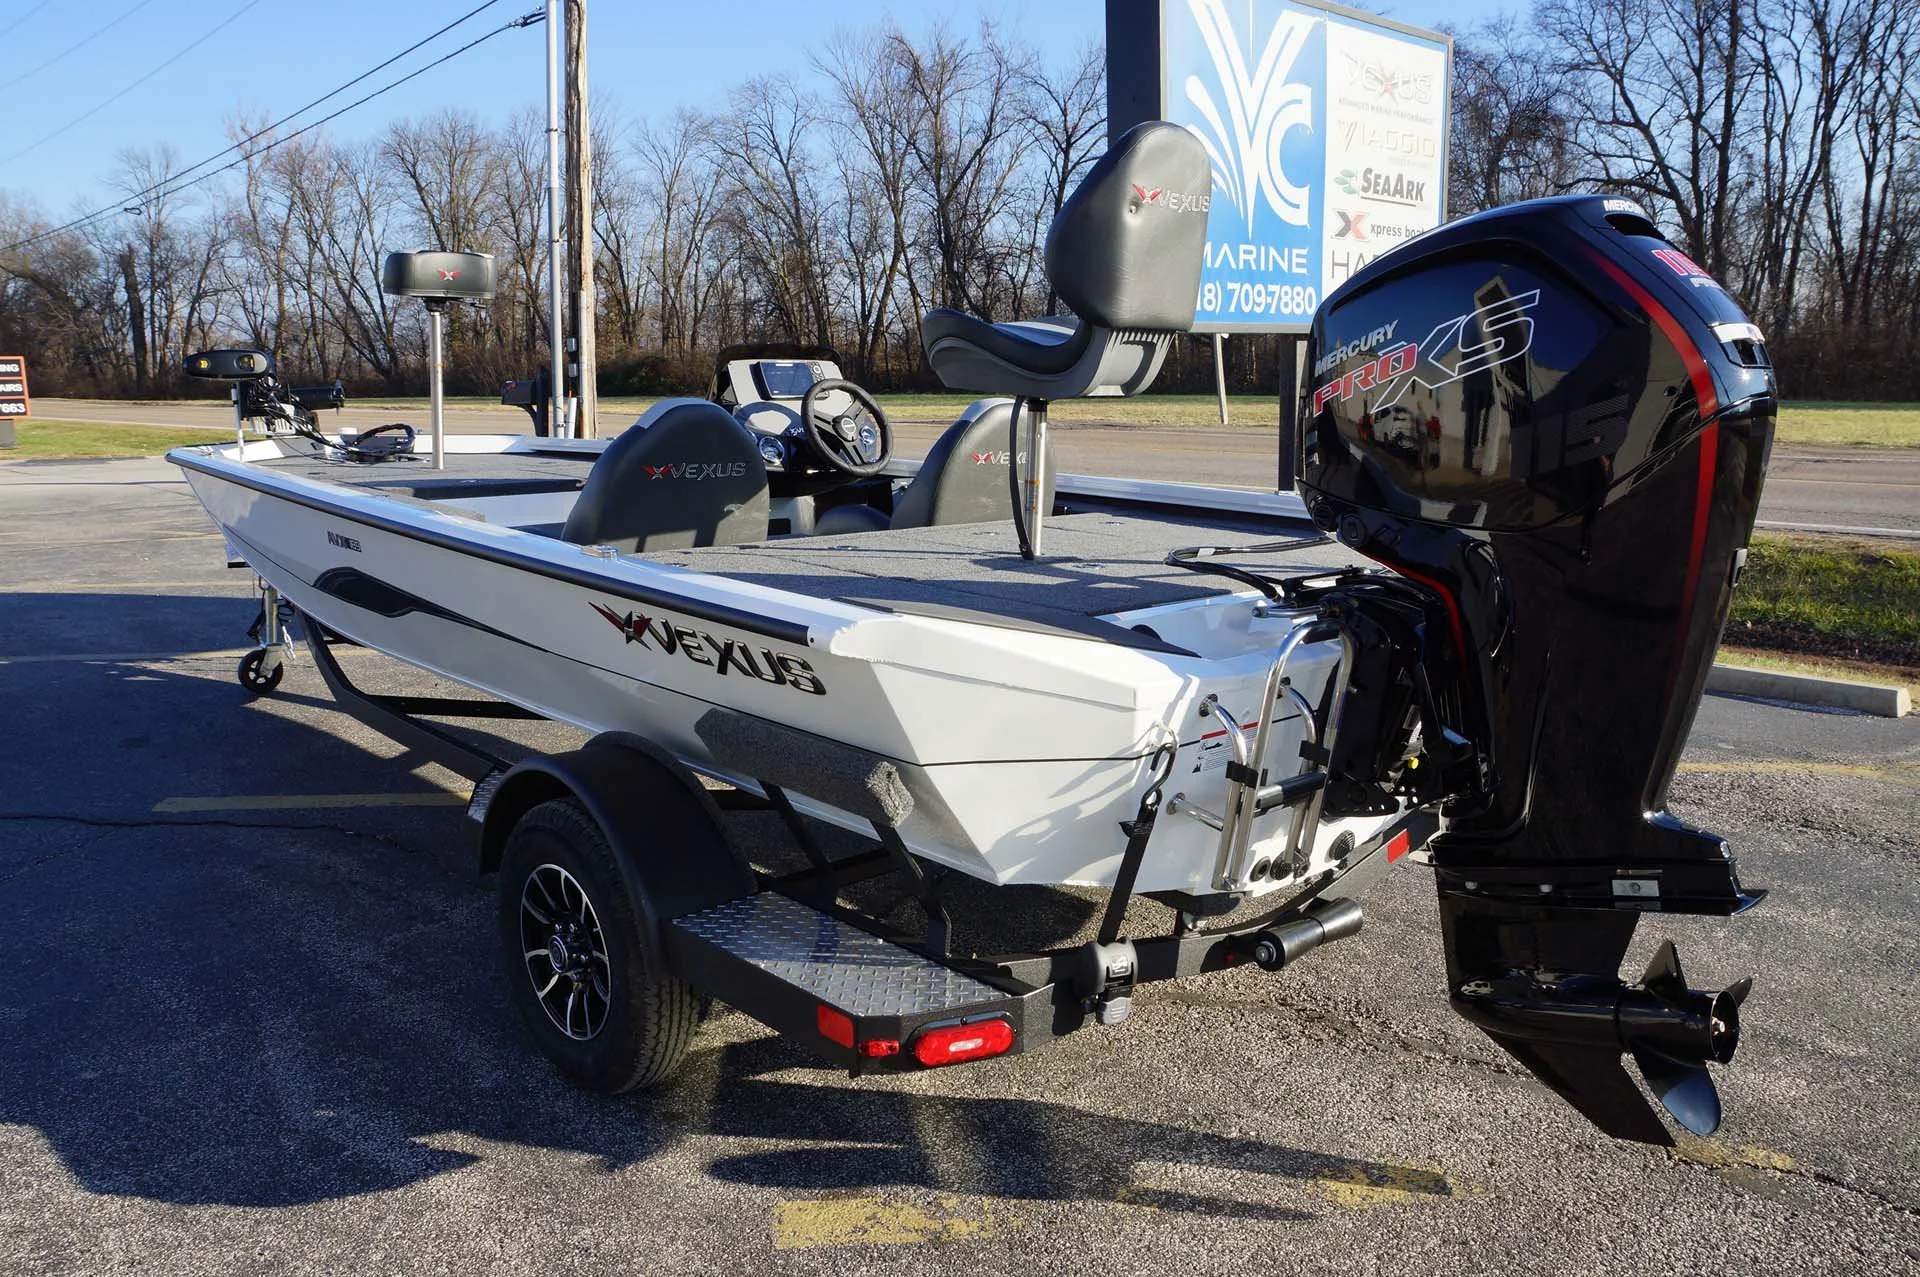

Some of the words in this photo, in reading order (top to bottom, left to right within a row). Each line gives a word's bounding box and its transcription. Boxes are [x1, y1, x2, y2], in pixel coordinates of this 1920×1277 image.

[1159, 190, 1210, 213] VEXUS
[1370, 223, 1402, 238] xpress
[1227, 282, 1316, 316] 709-7880
[1314, 319, 1399, 377] MERCURY
[1313, 343, 1418, 418] PRO
[668, 462, 746, 480] VEXUS
[648, 617, 826, 696] VEXUS
